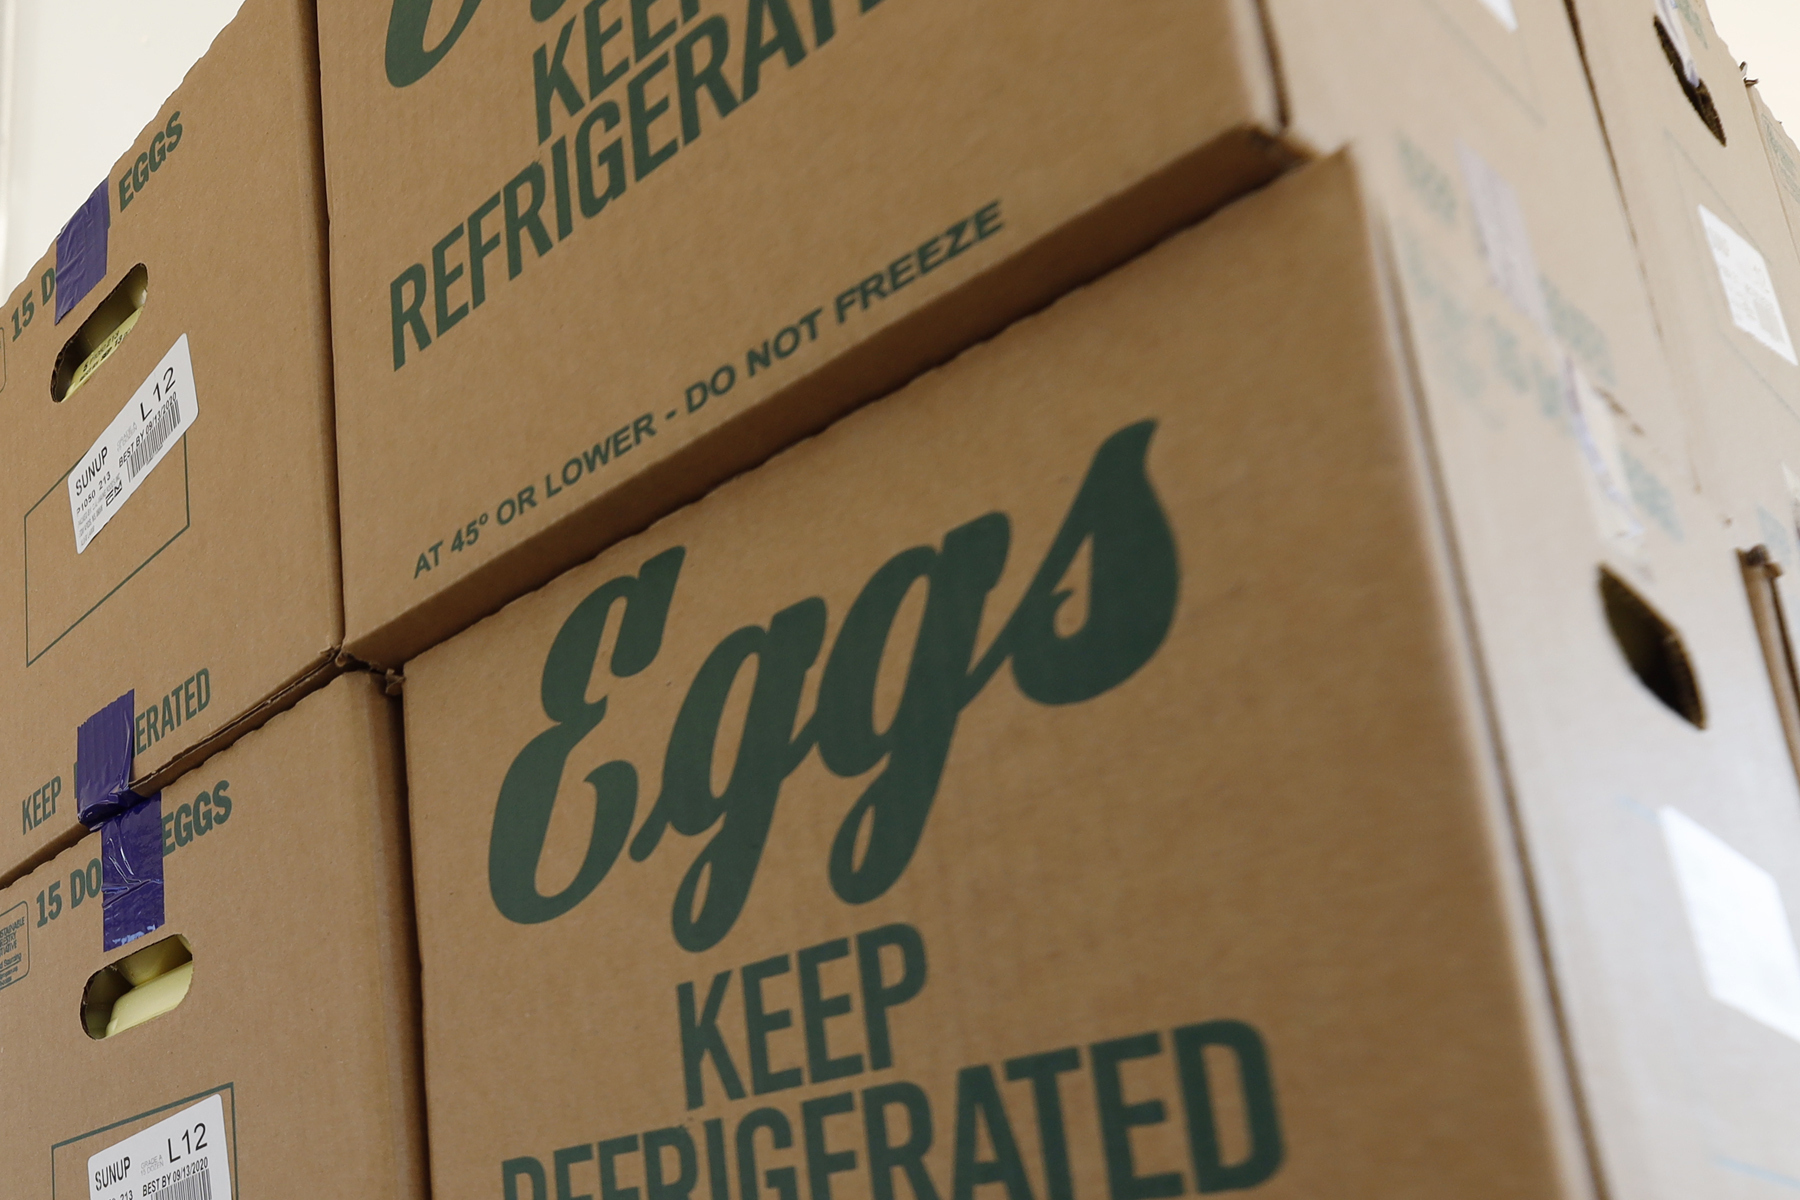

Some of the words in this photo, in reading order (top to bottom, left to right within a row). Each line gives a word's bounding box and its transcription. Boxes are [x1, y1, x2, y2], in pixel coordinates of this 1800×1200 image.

[532, 0, 700, 146] KEE
[12, 290, 34, 342] 15
[118, 110, 183, 213] EGGS
[98, 471, 111, 491] 213
[118, 443, 134, 468] BEST
[135, 432, 145, 447] BY
[145, 391, 177, 436] 09/13/2020
[413, 541, 444, 579] AT
[495, 485, 538, 528] OR
[544, 412, 657, 500] LOWER
[684, 363, 736, 415] DO
[746, 309, 824, 379] NOT
[834, 200, 1006, 324] FREEZE
[75, 446, 108, 496] SUNUP
[487, 418, 1181, 954] Eggs
[22, 775, 62, 835] KEEP
[36, 880, 62, 928] 15
[161, 780, 233, 857] EGGS
[676, 922, 929, 1110] KEEP
[95, 1156, 131, 1191] SUNUP
[142, 1178, 160, 1198] BEST
[161, 1171, 172, 1189] BY
[172, 1156, 209, 1183] 09/13/2020
